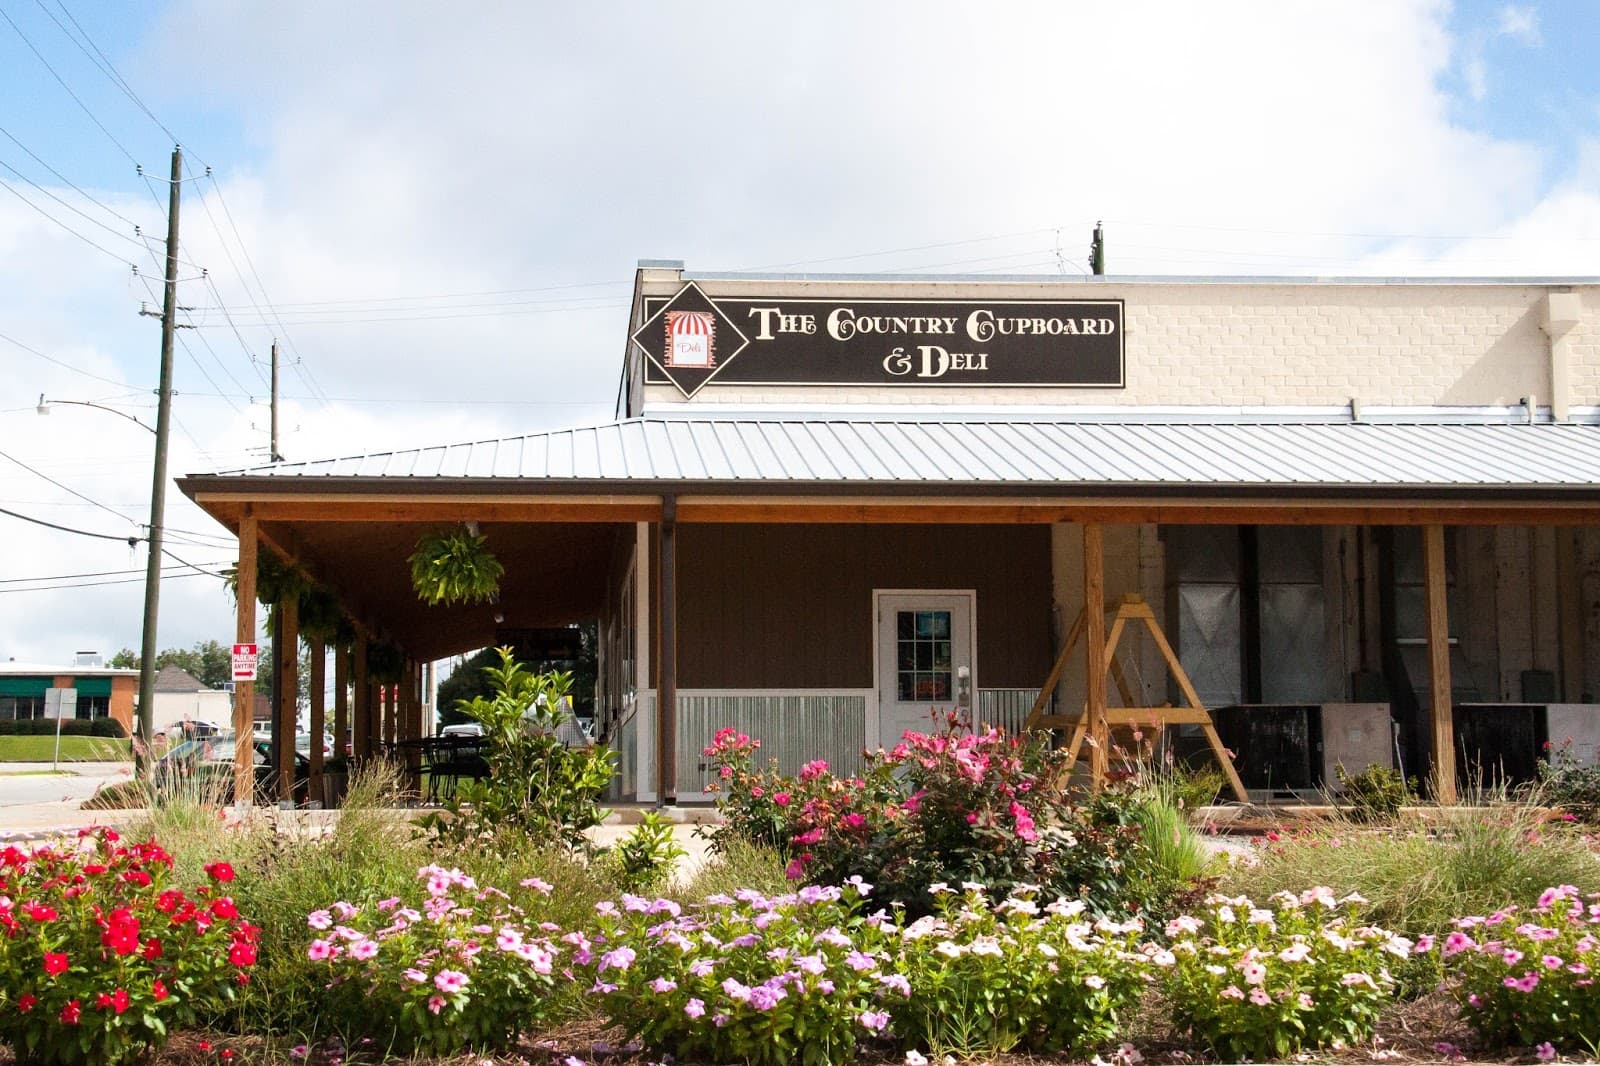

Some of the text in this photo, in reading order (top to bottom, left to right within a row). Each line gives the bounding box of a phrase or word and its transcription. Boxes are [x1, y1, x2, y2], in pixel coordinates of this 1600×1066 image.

[748, 307, 1115, 342] THE COUNTRY CUPBOARD
[883, 345, 989, 378] & DELI
[233, 654, 257, 662] PARKING
[240, 646, 250, 654] NO
